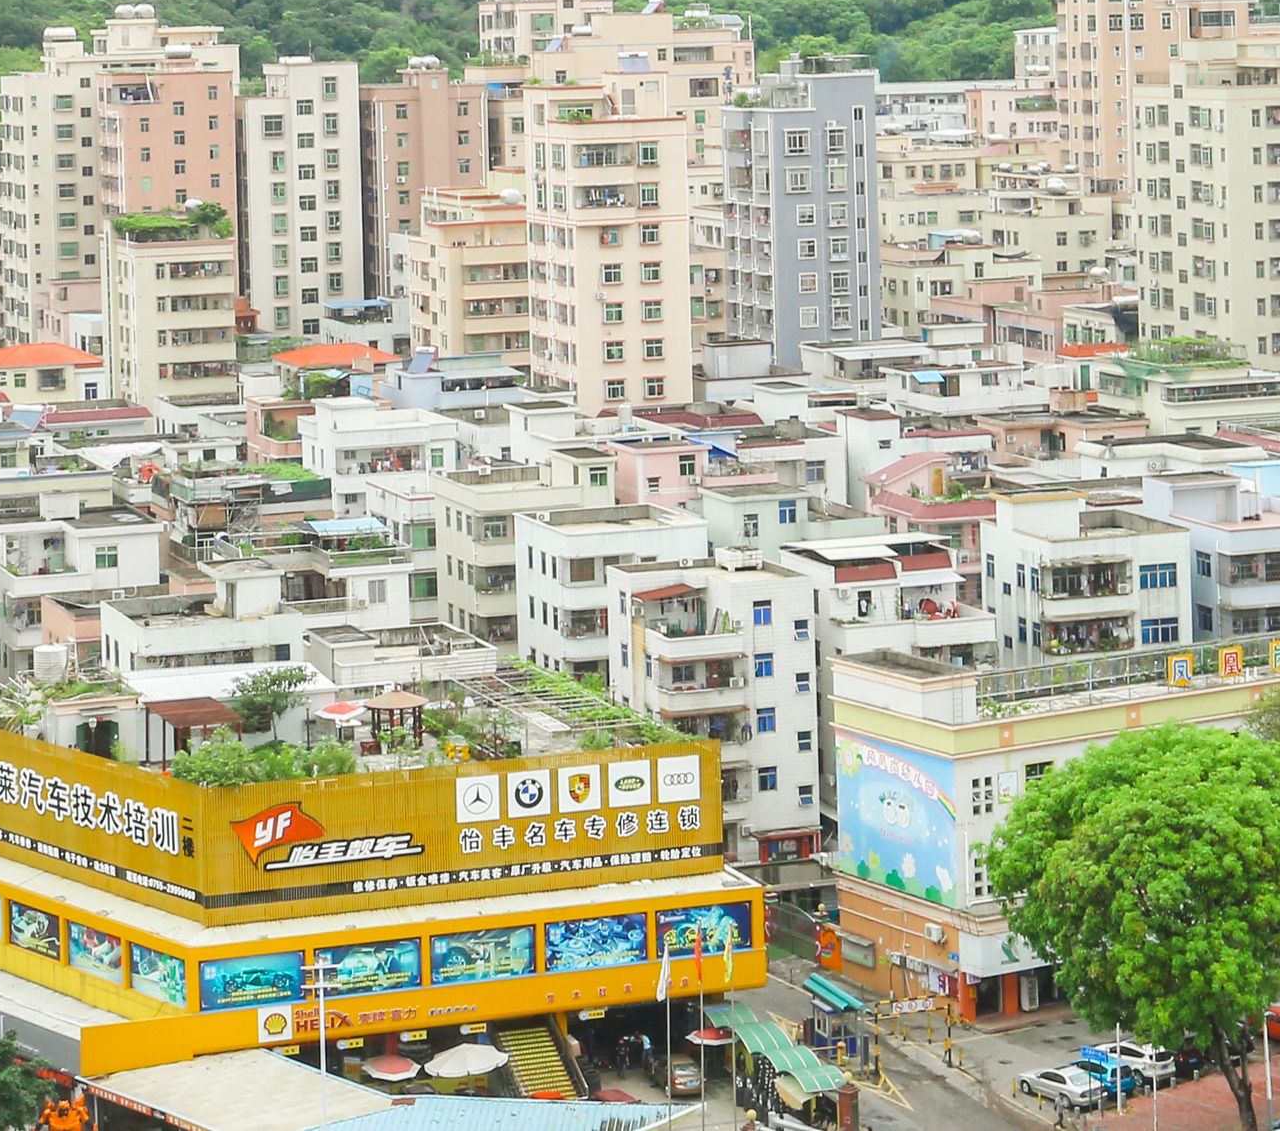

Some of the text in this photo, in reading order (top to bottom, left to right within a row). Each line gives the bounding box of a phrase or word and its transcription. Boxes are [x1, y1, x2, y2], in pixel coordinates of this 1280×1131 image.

[460, 806, 701, 854] 怡丰名车专修连锁
